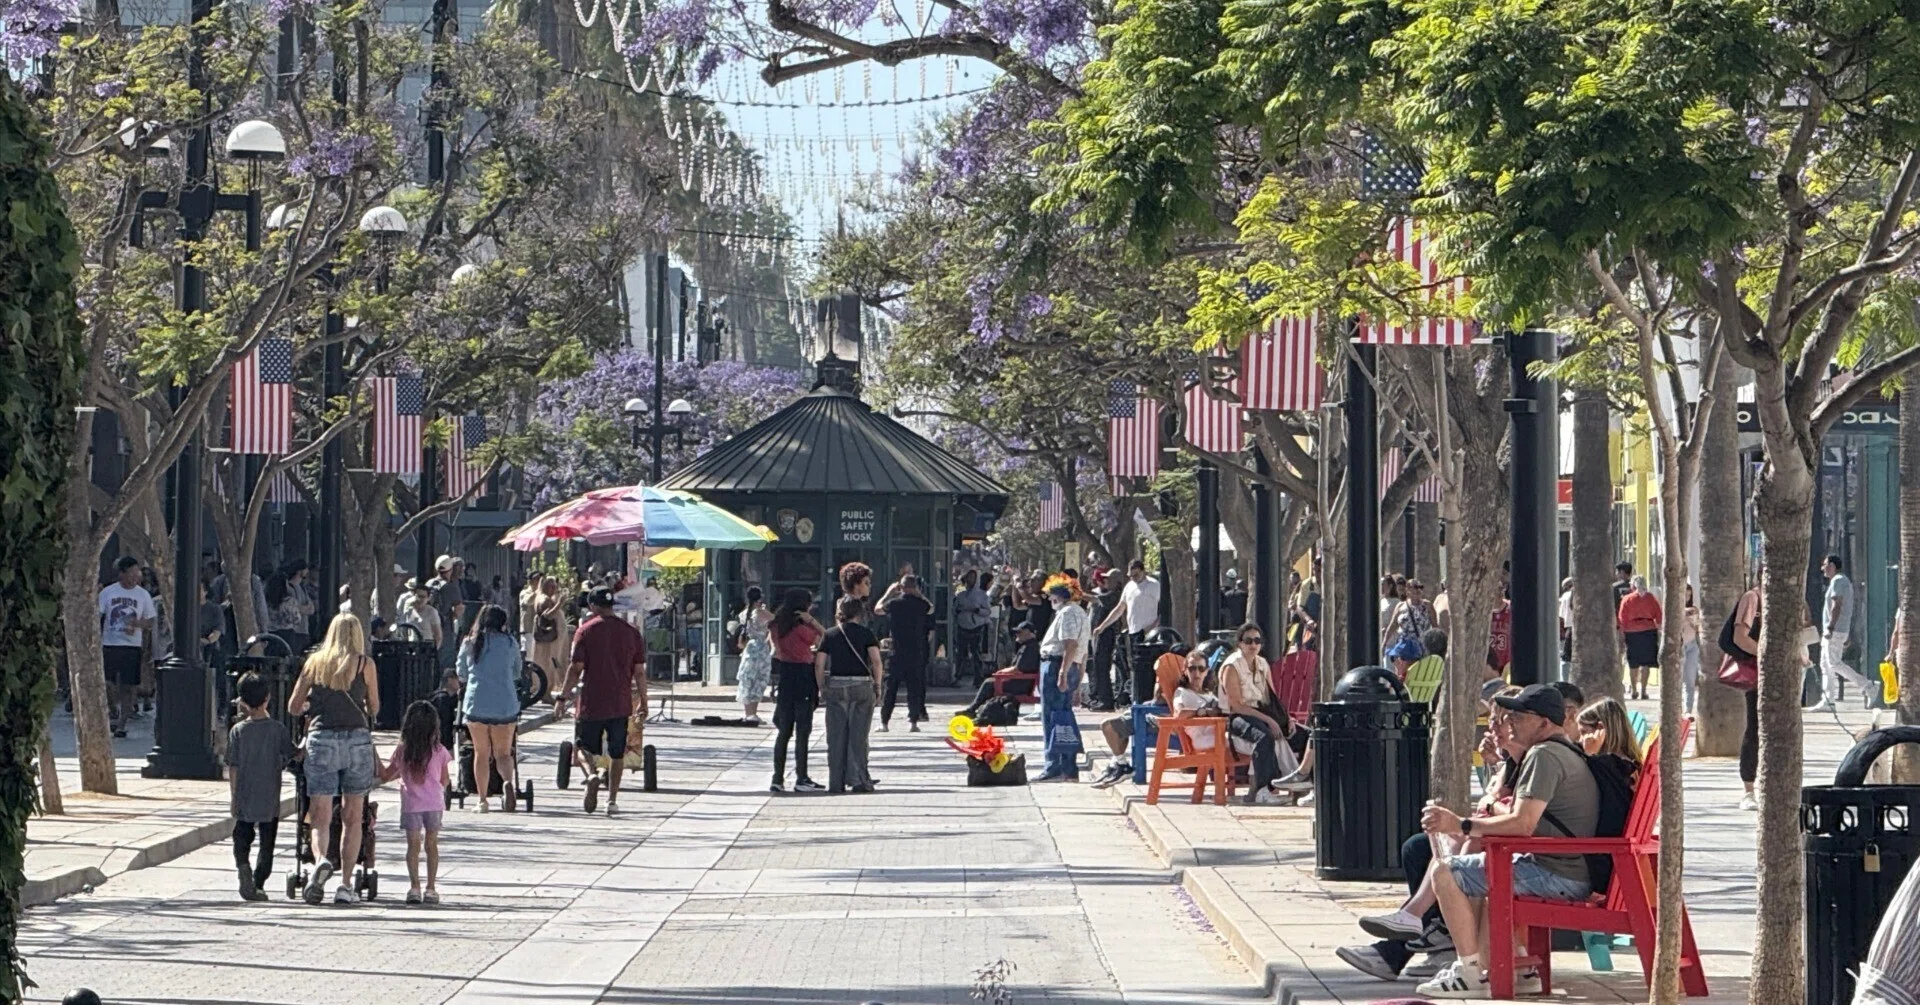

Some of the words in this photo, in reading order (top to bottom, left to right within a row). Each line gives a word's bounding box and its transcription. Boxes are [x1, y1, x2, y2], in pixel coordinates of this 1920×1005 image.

[841, 510, 874, 520] PUBLIC
[840, 521, 875, 531] SAFETY
[843, 532, 873, 542] KIOSK
[1489, 633, 1507, 651] 23
